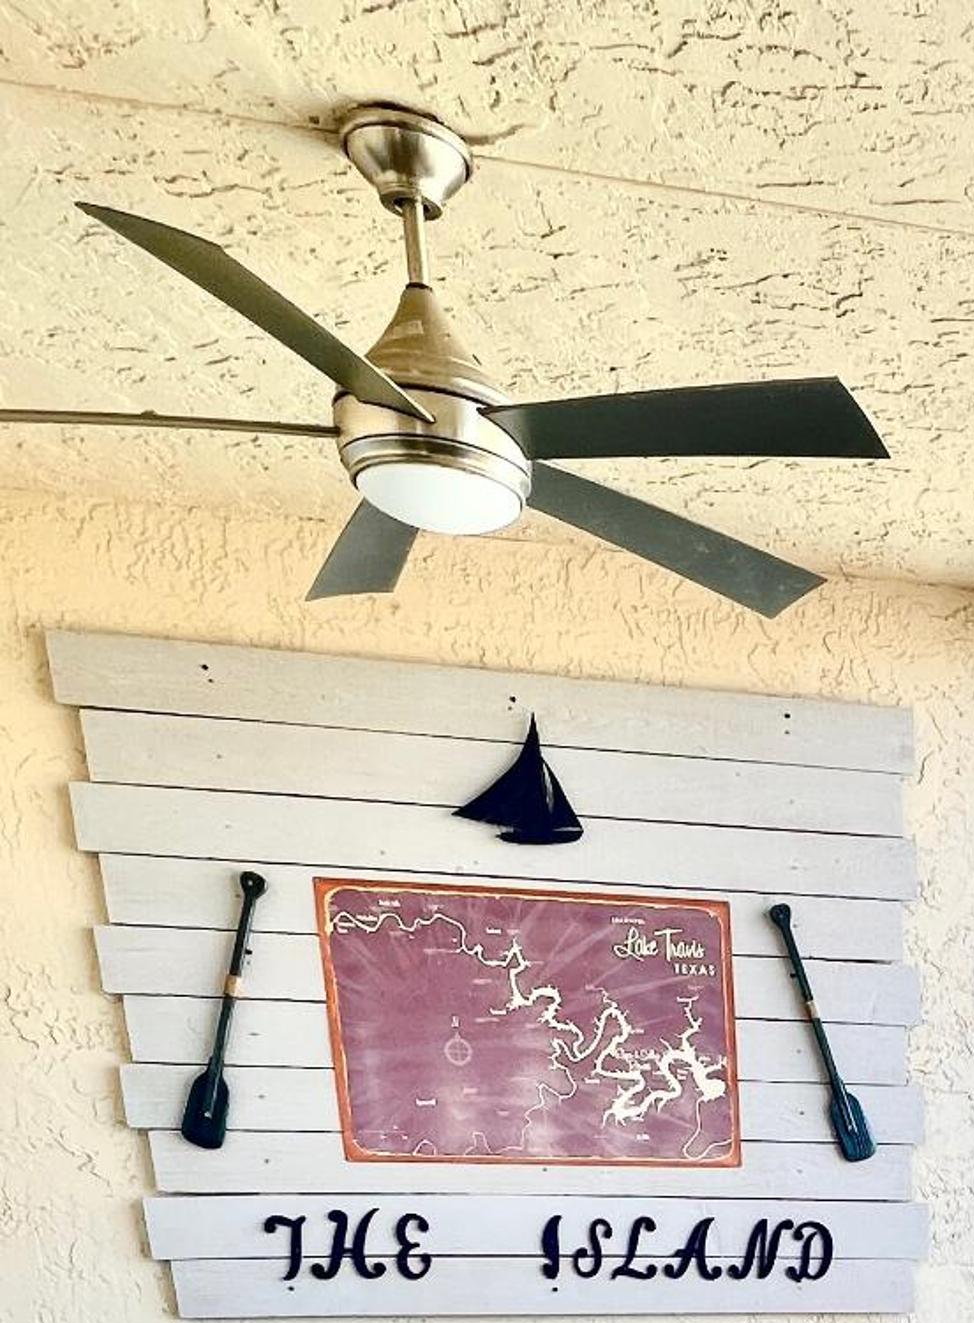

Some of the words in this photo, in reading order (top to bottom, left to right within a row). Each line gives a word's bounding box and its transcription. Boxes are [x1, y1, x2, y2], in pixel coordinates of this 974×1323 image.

[613, 927, 659, 962] Lake
[654, 928, 705, 962] Travis
[674, 963, 717, 977] TEXAS
[264, 1208, 433, 1282] THE
[541, 1214, 834, 1281] ISLAND
